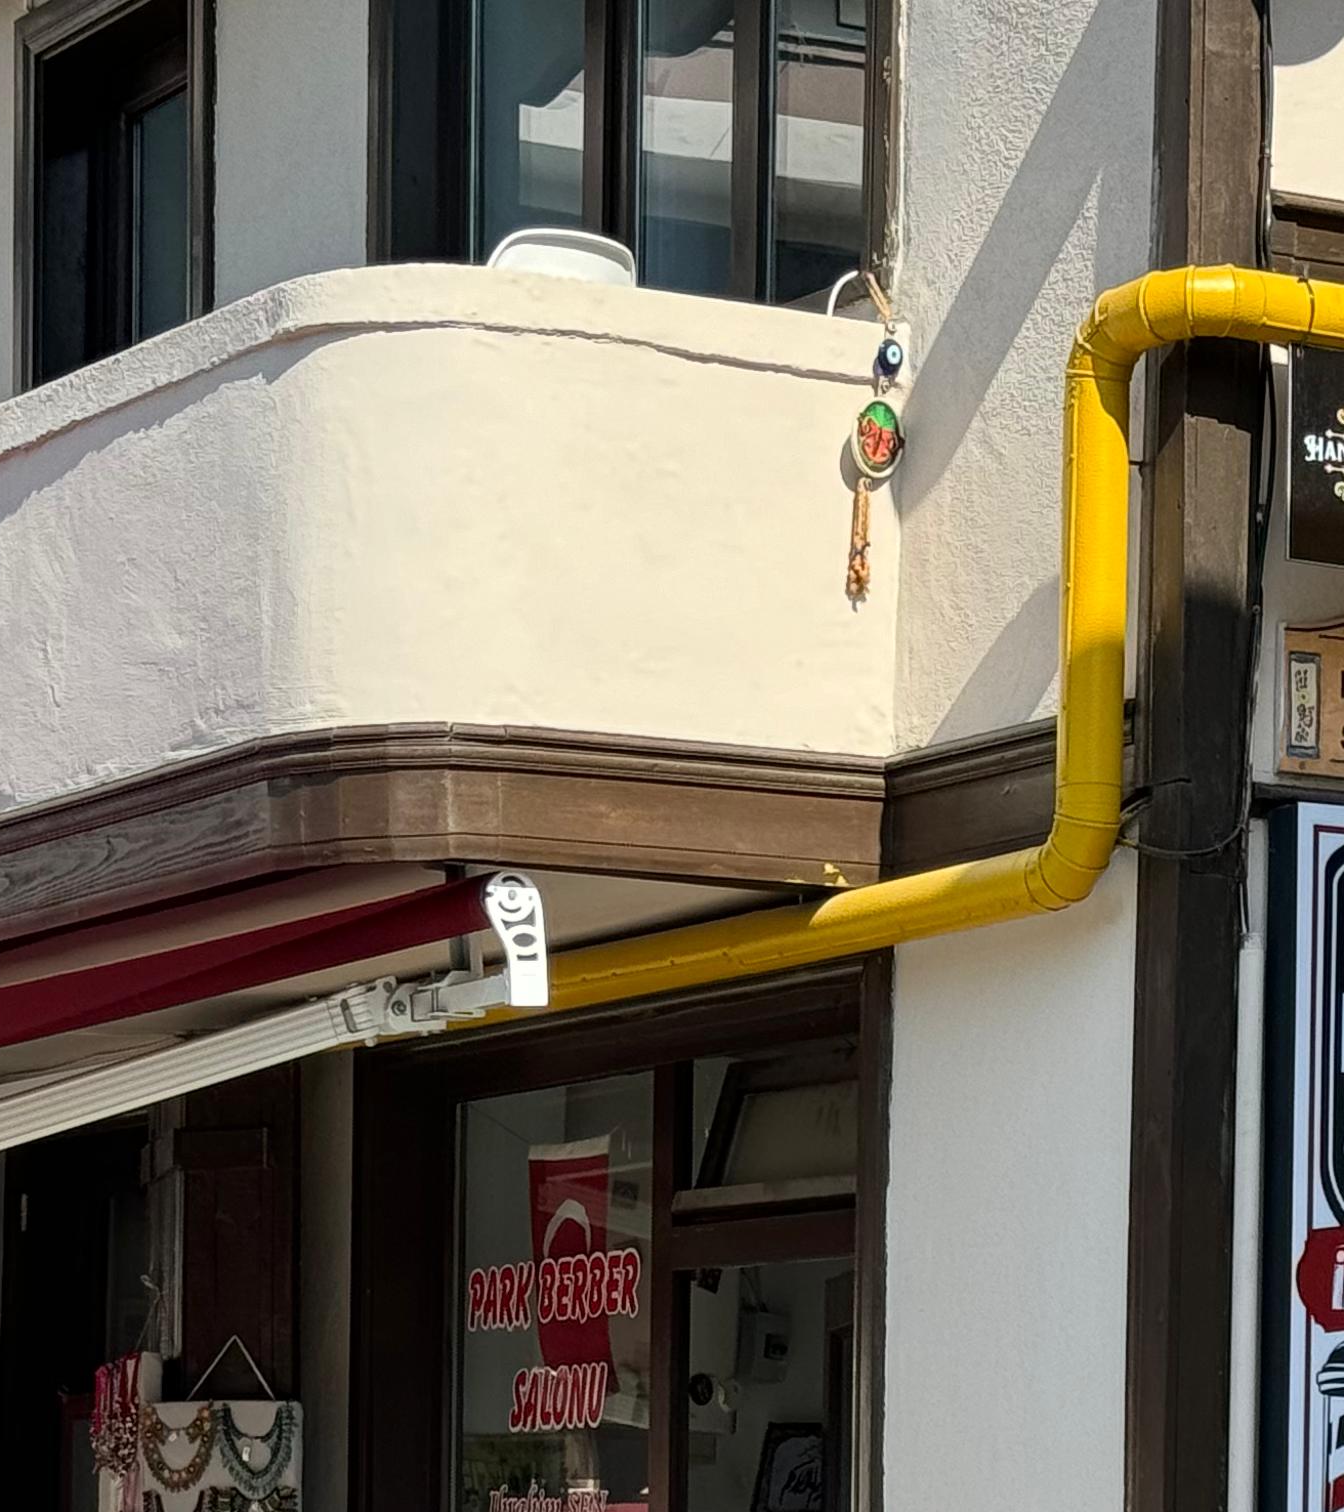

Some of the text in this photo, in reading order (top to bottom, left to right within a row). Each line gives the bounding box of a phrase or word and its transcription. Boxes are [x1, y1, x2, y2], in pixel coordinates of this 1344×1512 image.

[468, 1247, 640, 1332] PARK BERBER
[509, 1361, 607, 1433] SALONU
